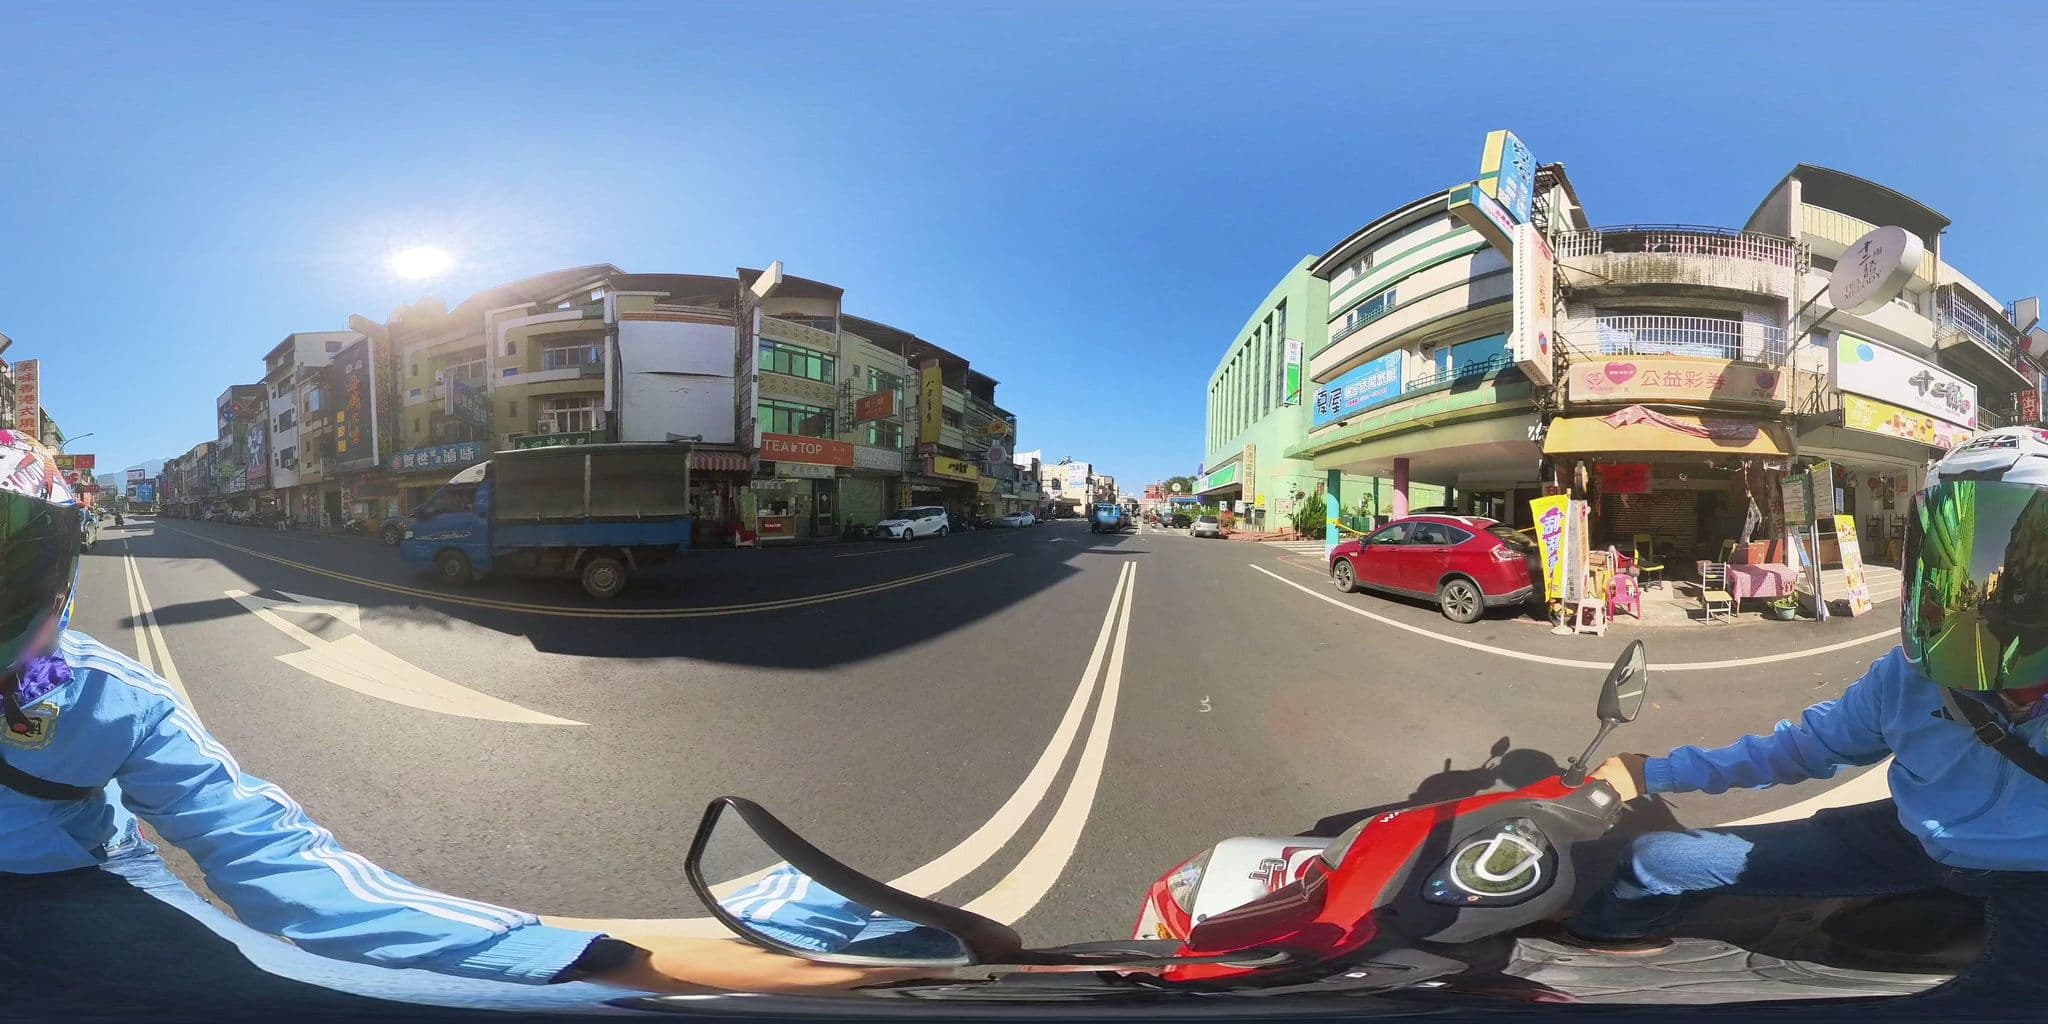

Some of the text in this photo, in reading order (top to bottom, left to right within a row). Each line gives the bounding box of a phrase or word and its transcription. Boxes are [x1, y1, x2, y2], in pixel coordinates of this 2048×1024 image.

[1641, 369, 1726, 390] 公益彩券
[763, 439, 789, 452] TEA
[797, 442, 823, 455] TOP
